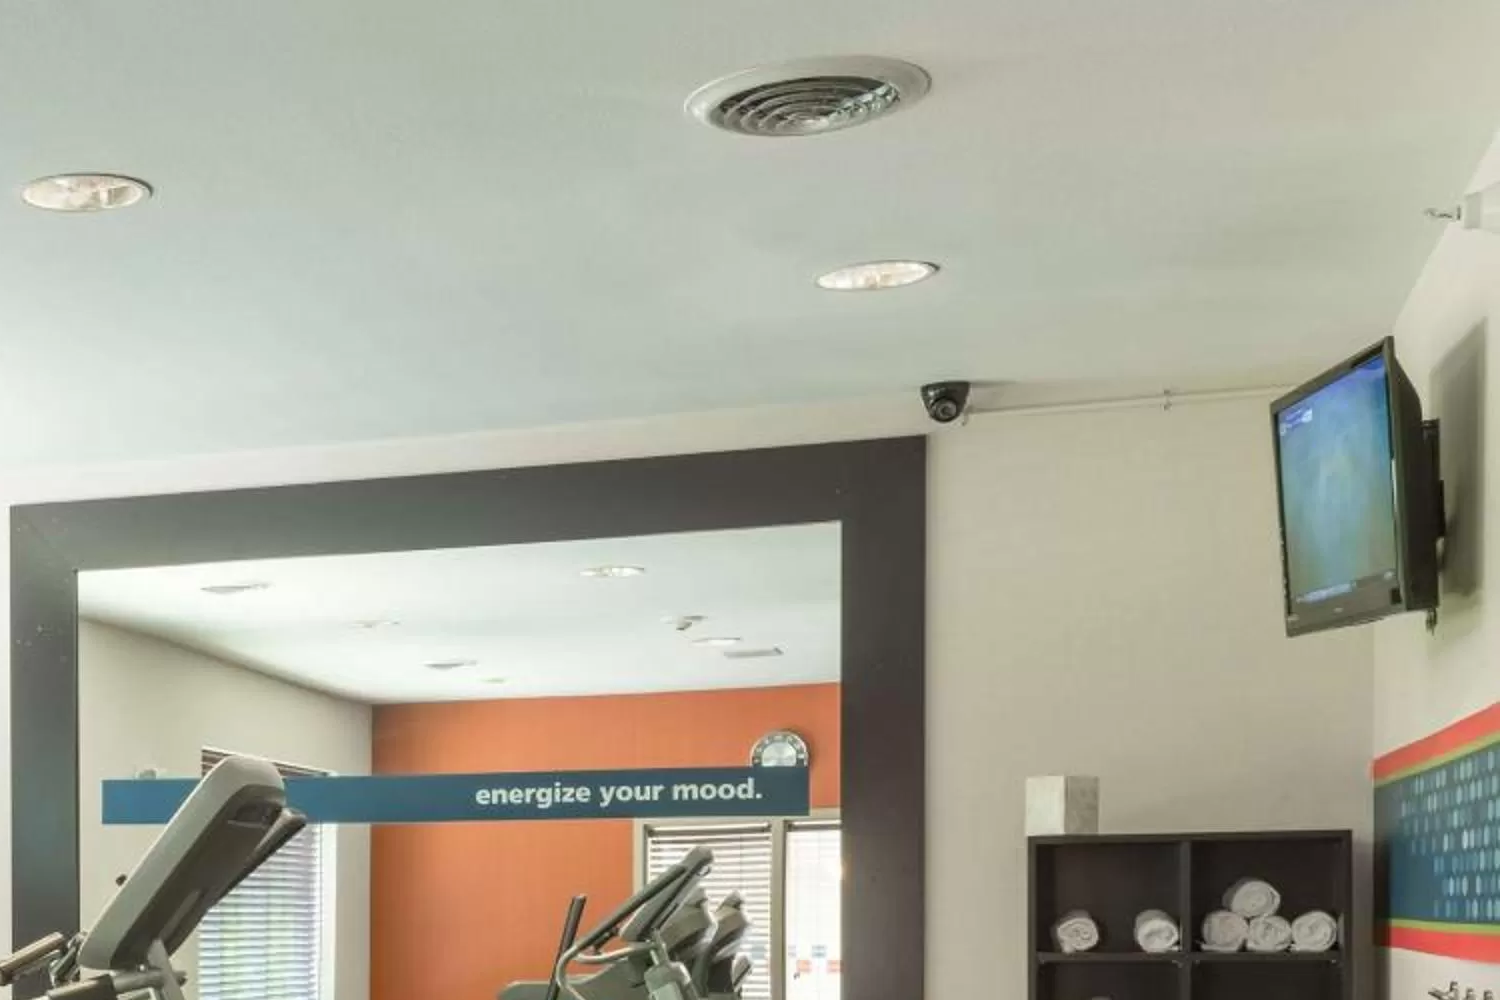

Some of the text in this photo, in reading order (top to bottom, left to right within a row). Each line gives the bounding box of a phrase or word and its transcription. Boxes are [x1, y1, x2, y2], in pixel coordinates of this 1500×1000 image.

[475, 778, 763, 808] energize your mood.
